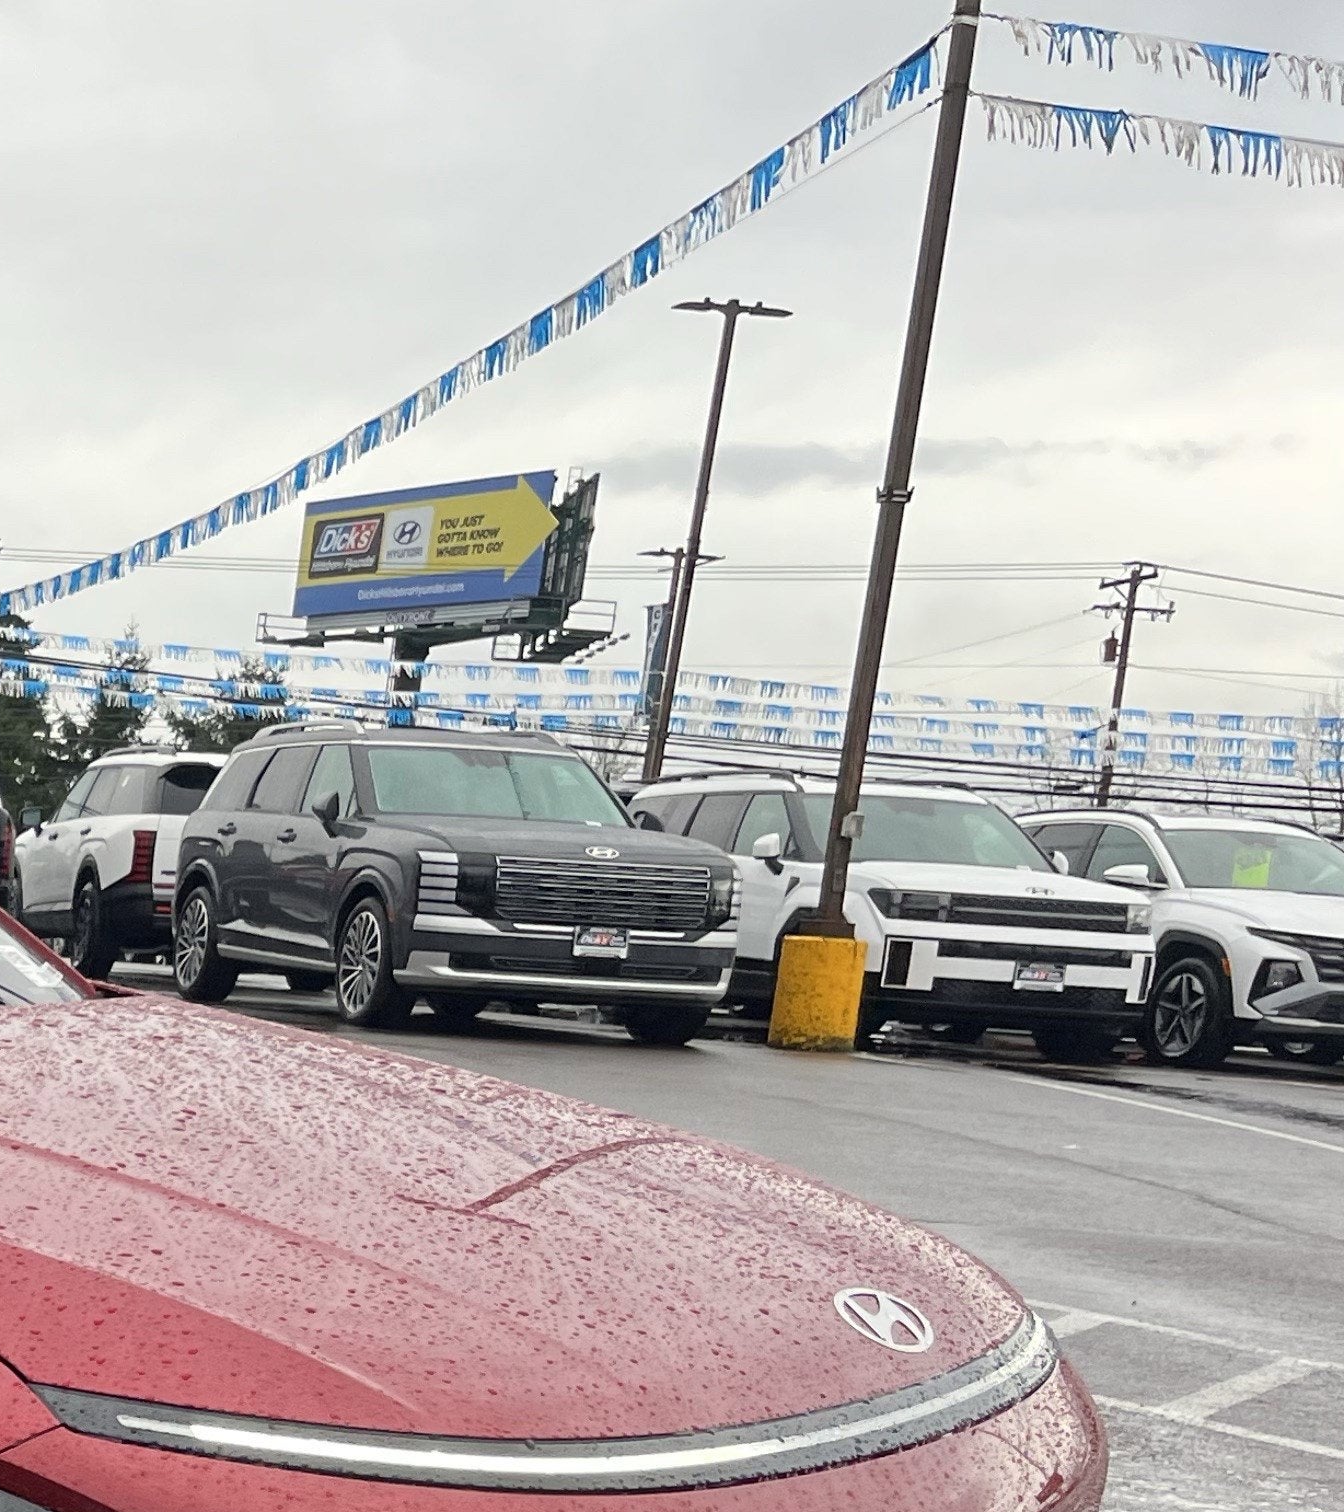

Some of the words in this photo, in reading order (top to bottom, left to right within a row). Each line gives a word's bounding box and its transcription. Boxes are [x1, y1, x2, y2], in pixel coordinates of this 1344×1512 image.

[440, 516, 459, 528] YOU
[460, 514, 485, 527] JUST
[320, 521, 376, 553] Dick's
[437, 530, 467, 543] GOTTA
[467, 527, 500, 542] KNOW
[436, 545, 470, 558] WHERE
[472, 543, 485, 556] TO
[487, 540, 503, 554] GO!
